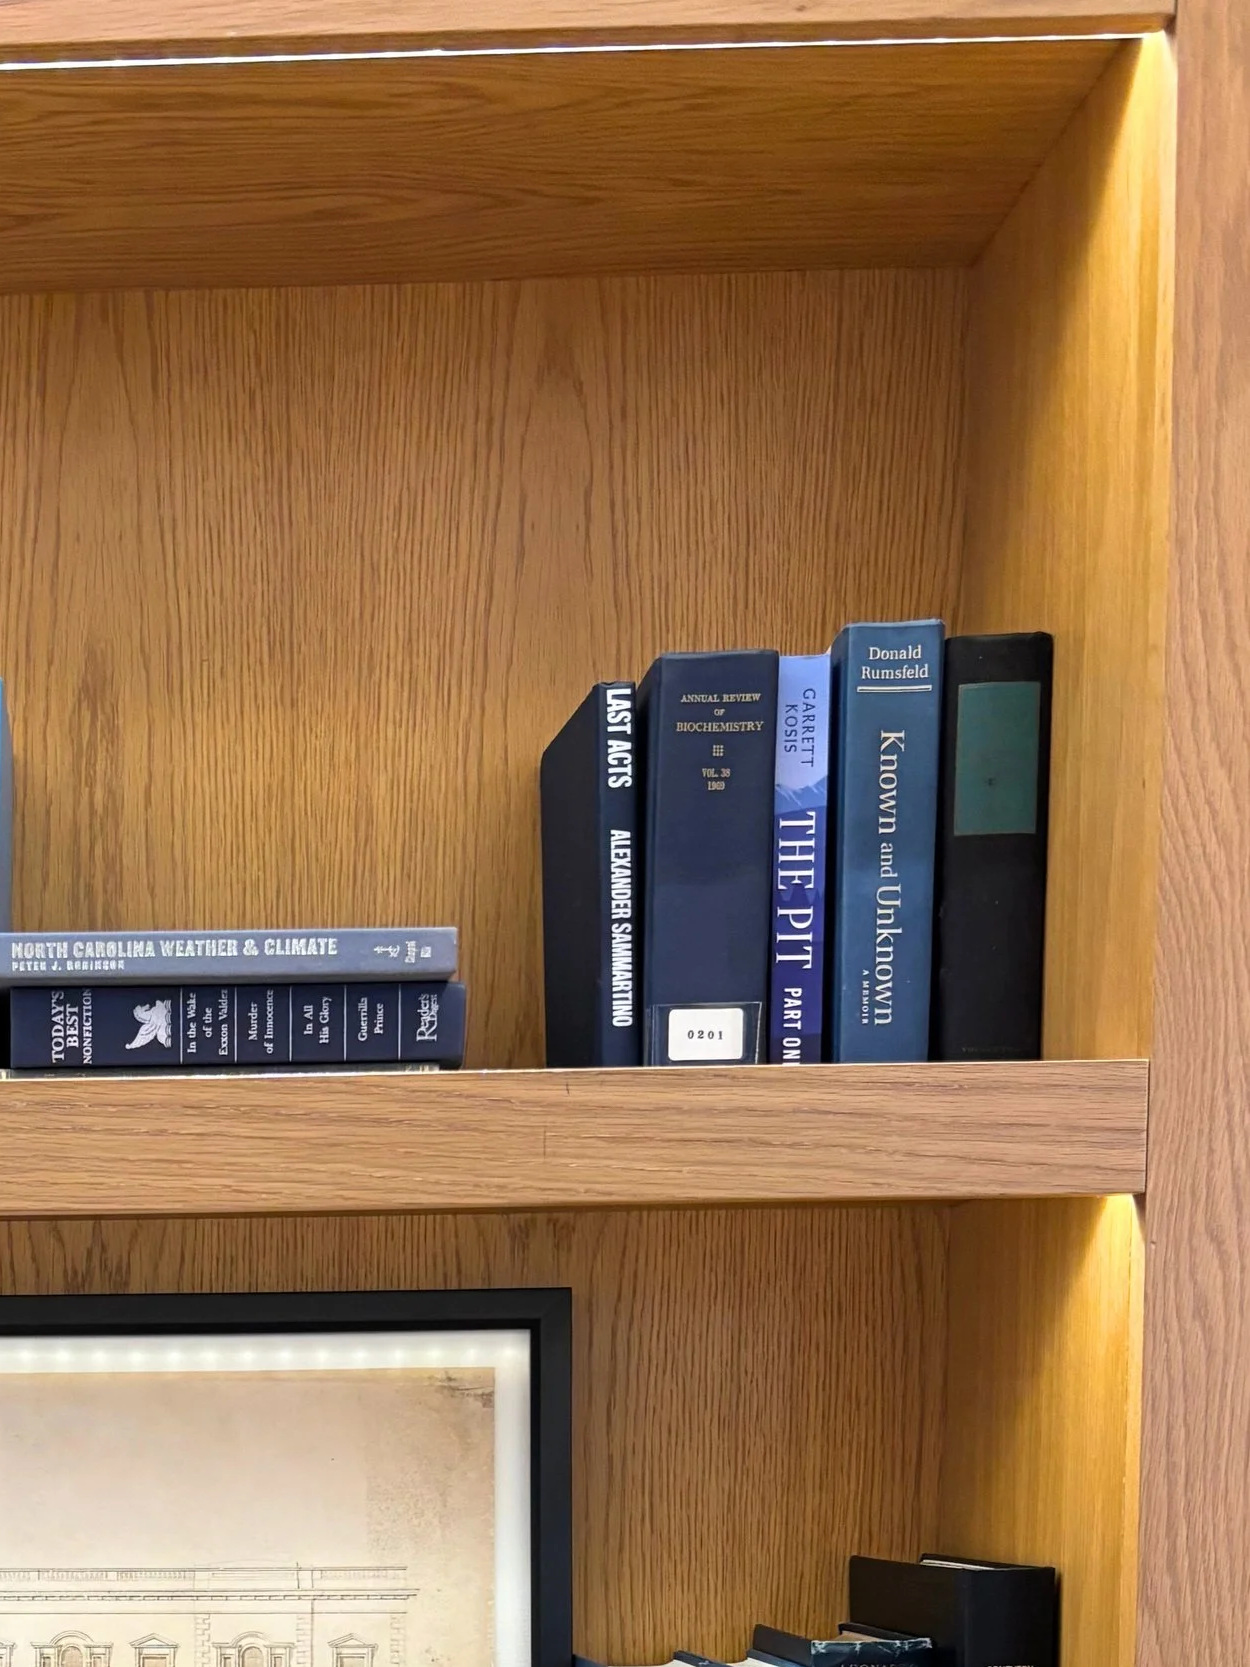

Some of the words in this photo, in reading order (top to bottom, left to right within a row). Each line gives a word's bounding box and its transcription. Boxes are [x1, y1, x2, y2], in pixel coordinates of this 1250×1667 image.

[868, 645, 922, 661] Donald
[861, 664, 929, 681] Rumsfeld
[607, 688, 632, 734] LAST
[676, 720, 765, 733] BIOCHEMISTRY
[785, 703, 798, 754] KOSIS
[803, 688, 816, 768] GARRETT
[607, 740, 632, 789] ACTS
[878, 729, 904, 834] Known
[777, 810, 816, 891] THE
[879, 842, 894, 879] and
[610, 829, 631, 919] ALEXANDER
[11, 940, 69, 959] NORTH
[72, 939, 156, 958] CAROLINA
[160, 938, 238, 957] WEATHER
[242, 938, 259, 956] &
[264, 937, 338, 956] CLIMATE
[776, 905, 814, 970] PIT
[874, 885, 902, 1026] Unknown
[611, 923, 632, 1027] SAMMARTINO
[187, 991, 197, 1018] Wake
[202, 1006, 213, 1024] the
[218, 989, 229, 1020] Valdez
[264, 989, 274, 1039] Innocence
[303, 1004, 313, 1020] All
[319, 996, 332, 1024] Glory
[357, 996, 368, 1041] Guerrilla
[373, 1002, 384, 1034] Prince
[783, 987, 803, 1030] PART
[861, 980, 869, 1025] MEMOIR
[51, 989, 65, 1063] TODAY'S
[66, 1003, 79, 1048] BEST
[83, 988, 93, 1064] NONFICTION
[187, 1022, 197, 1038] the
[202, 1026, 213, 1038] of
[248, 1001, 258, 1041] Murder
[303, 1022, 313, 1035] In
[319, 1026, 329, 1044] His
[687, 1029, 724, 1041] 0201
[187, 1043, 197, 1053] In
[218, 1023, 229, 1056] Exxon
[264, 1042, 274, 1054] of
[782, 1036, 801, 1065] ON
